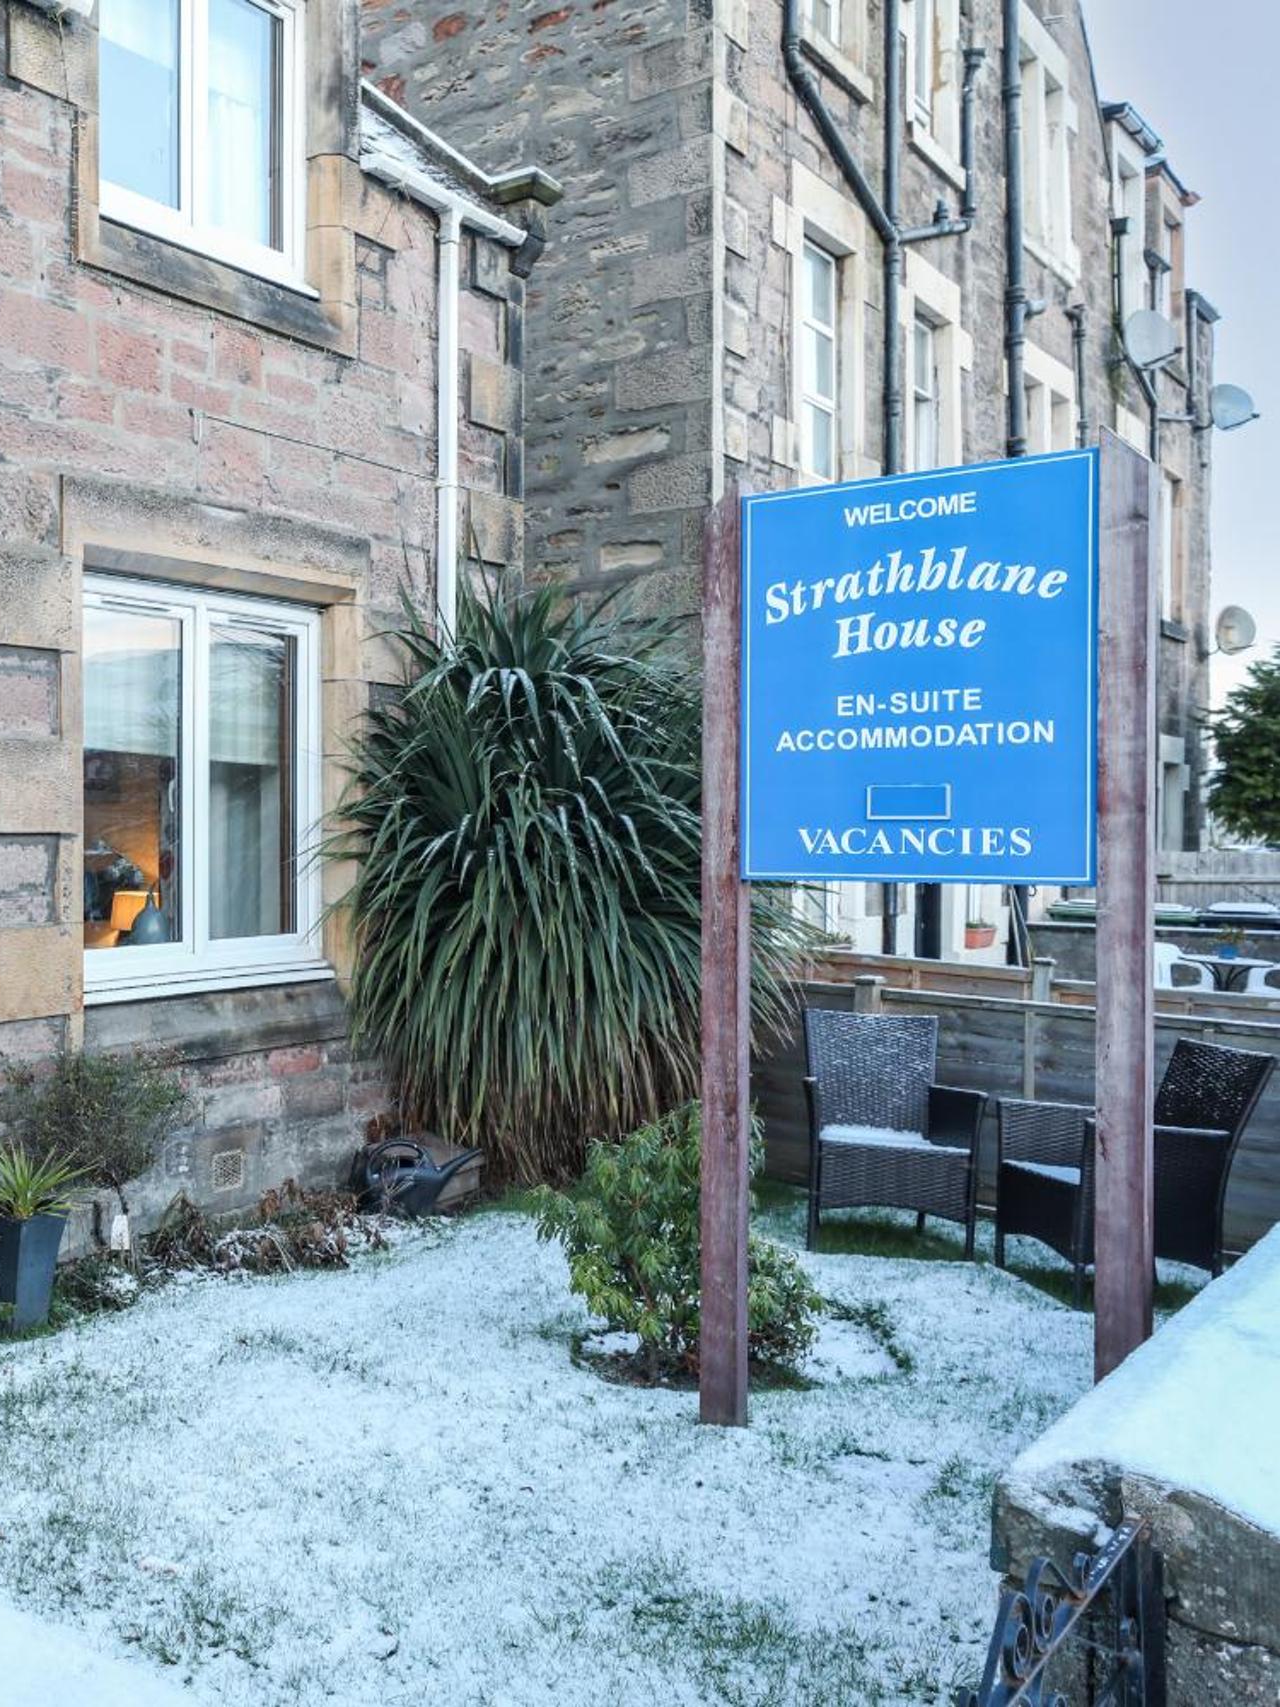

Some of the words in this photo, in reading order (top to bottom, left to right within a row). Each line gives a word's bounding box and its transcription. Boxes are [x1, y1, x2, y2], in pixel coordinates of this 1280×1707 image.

[844, 492, 977, 527] WELCOME
[765, 546, 1068, 625] Strathblane
[833, 613, 987, 658] House
[837, 688, 982, 717] EN-SUITE
[776, 720, 1054, 752] ACCOMMODATION
[799, 828, 1032, 856] VACANCIES
